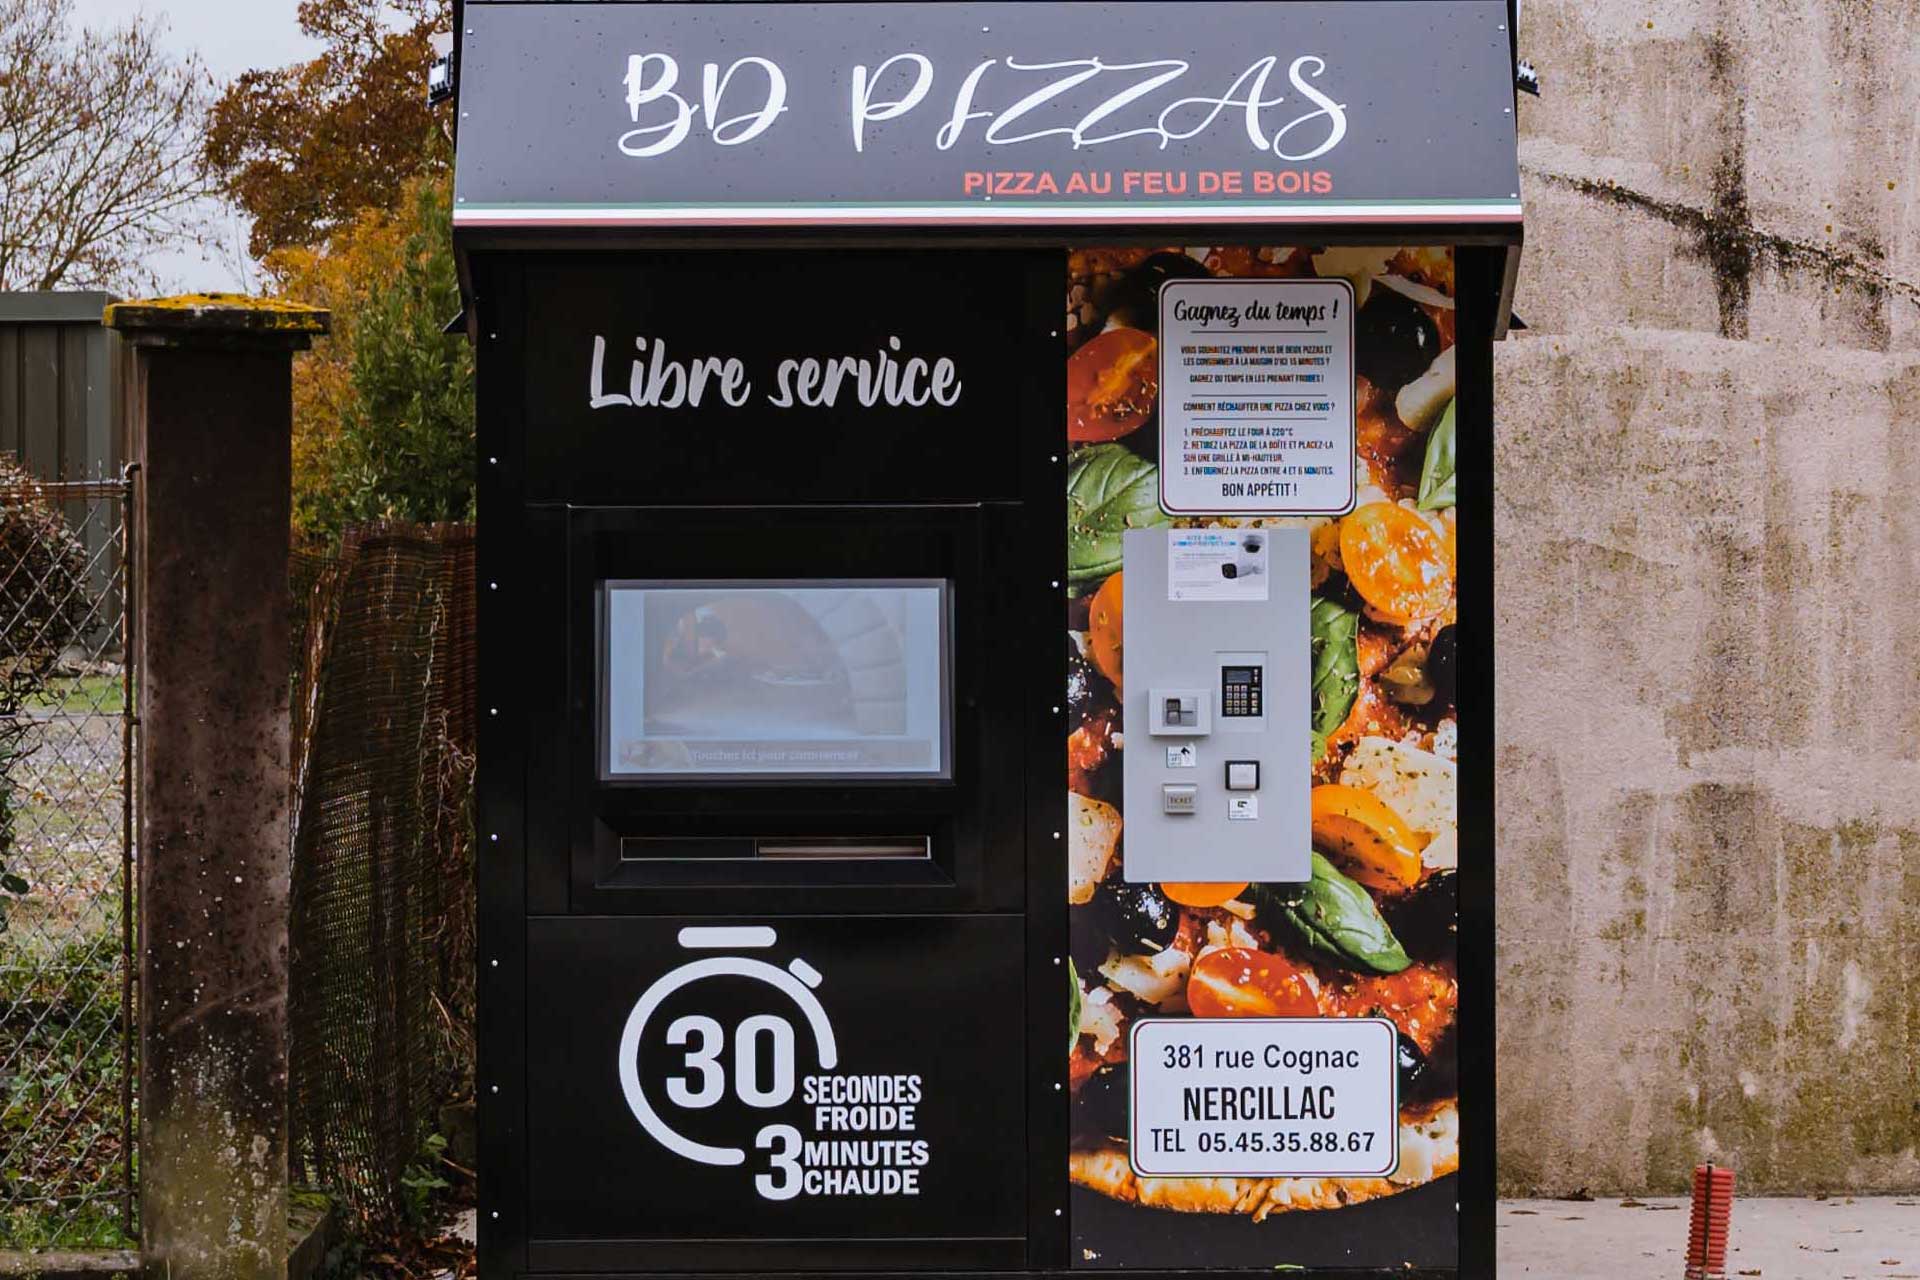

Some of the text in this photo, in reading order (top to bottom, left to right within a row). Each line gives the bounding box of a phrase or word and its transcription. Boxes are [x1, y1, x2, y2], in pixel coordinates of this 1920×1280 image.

[618, 52, 1347, 160] BD PIZZAS
[964, 171, 1333, 194] PIZZA AU FEU DE BOIS
[1174, 300, 1241, 327] Gagnez
[1245, 300, 1270, 320] du
[1275, 302, 1325, 326] temps
[1181, 345, 1196, 354] VOUS
[1232, 345, 1258, 354] PRENDRE
[1260, 345, 1275, 354] PLUS
[1276, 345, 1284, 354] DE
[1303, 345, 1323, 354] PIZZAS
[1325, 345, 1332, 354] ET
[1183, 357, 1194, 366] LES
[1240, 357, 1248, 366] LA
[590, 335, 962, 409] Libre service
[1190, 374, 1213, 383] GAGNEZ
[1215, 374, 1223, 383] DU
[1224, 374, 1244, 383] TEMPS
[1245, 374, 1253, 383] EN
[1254, 374, 1265, 383] LES
[1267, 374, 1294, 383] PRENANT
[1183, 402, 1215, 411] COMMENT
[1260, 402, 1273, 411] UNE
[1274, 402, 1293, 411] PIZZA
[1295, 402, 1311, 411] CHEZ
[1313, 402, 1329, 411] VOUS
[1191, 426, 1236, 436] PRÉCHAUFFEZ
[1238, 428, 1245, 436] LE
[1247, 428, 1264, 436] FOUR
[1191, 441, 1218, 449] RETIREZ
[1219, 441, 1228, 449] LA
[1229, 441, 1248, 449] PIZZA
[1249, 441, 1257, 449] DE
[1259, 441, 1267, 449] LA
[1269, 439, 1287, 449] BOÎTE
[1289, 441, 1296, 449] ET
[1298, 441, 1333, 449] PLACEZ-LA
[1183, 454, 1196, 462] SUR
[1198, 454, 1210, 462] UNE
[1213, 454, 1233, 462] GRILLE
[1230, 467, 1238, 475] LA
[1240, 467, 1259, 475] PIZZA
[1260, 467, 1280, 475] ENTRE
[1288, 467, 1296, 475] ET
[1222, 483, 1243, 496] BON
[1247, 480, 1291, 496] APPÉTIT
[666, 1014, 795, 1108] 30
[1163, 1044, 1360, 1074] 381 rue Cognac
[803, 1075, 922, 1105] SECONDES
[1184, 1085, 1336, 1121] NERCILLAC
[815, 1106, 915, 1131] FROIDE
[1150, 1128, 1376, 1153] TEL 05.45.35.88.67
[755, 1124, 929, 1200] 3 MINUTES
[804, 1169, 920, 1195] CHAUDE
